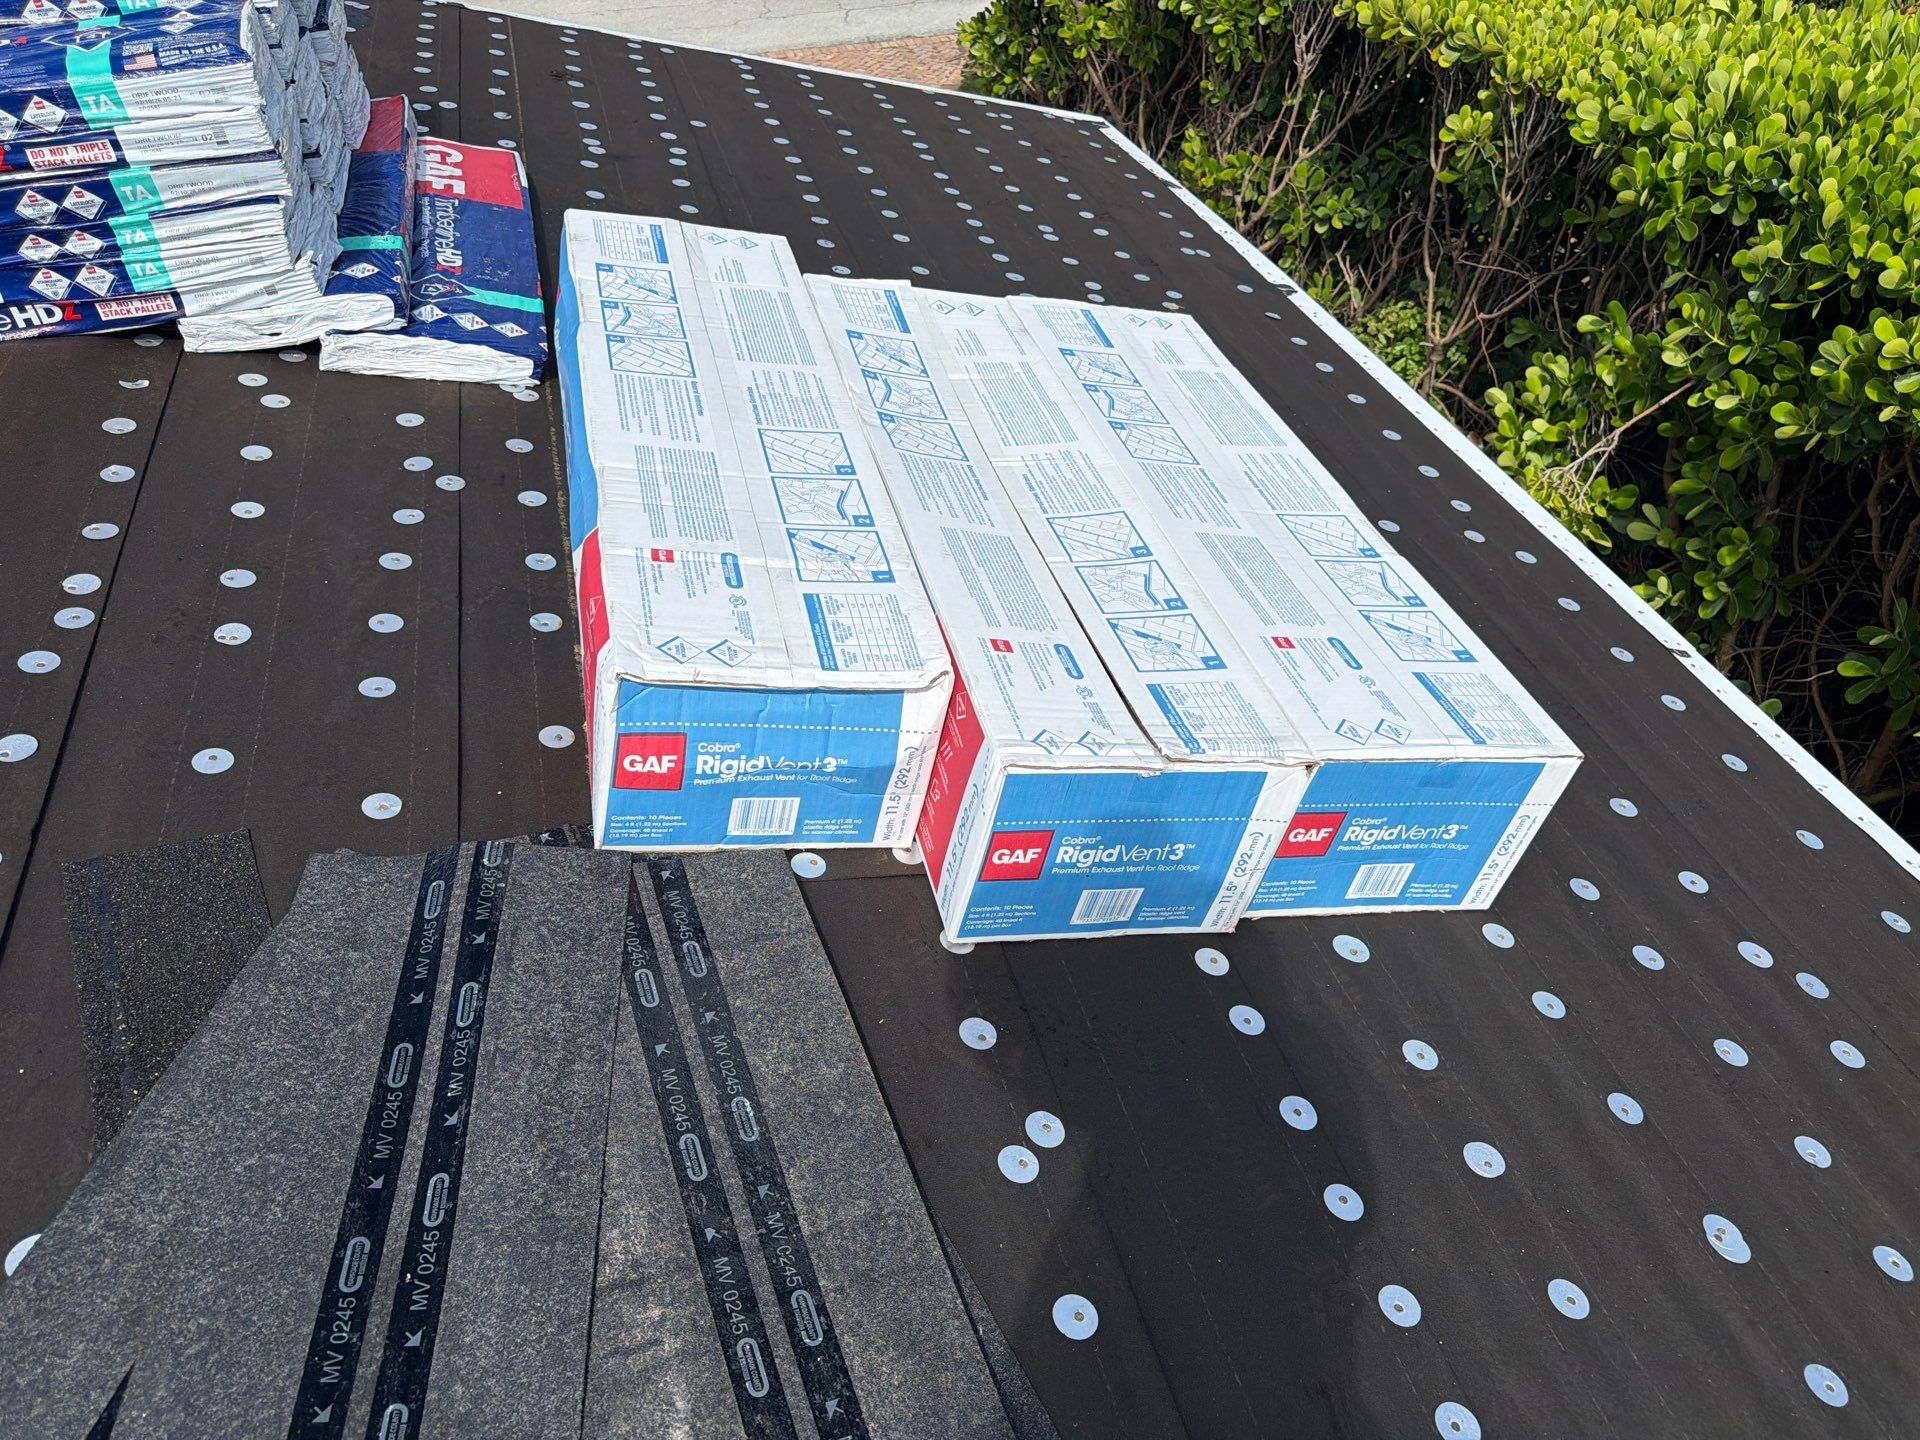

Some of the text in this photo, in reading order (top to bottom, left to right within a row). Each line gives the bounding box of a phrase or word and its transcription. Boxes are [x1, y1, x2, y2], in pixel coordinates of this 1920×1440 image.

[206, 43, 227, 52] U.S.A.
[132, 88, 179, 99] DRIFTWOOD
[83, 95, 119, 113] TA
[202, 134, 214, 142] 02
[30, 142, 110, 160] DO NOT TRIPLE
[34, 151, 113, 169] STACK PALLETS
[416, 145, 465, 195] GAF
[121, 185, 153, 201] TA
[168, 180, 213, 190] DRIFTWOOD
[122, 230, 149, 244] TA
[133, 264, 162, 277] TA
[103, 303, 173, 318] STACK PALLETS
[117, 300, 134, 308] NOT
[138, 296, 170, 306] TRIPLE
[623, 755, 678, 774] GAF
[694, 776, 736, 786] Premium
[738, 774, 773, 782] Exhaust
[832, 776, 858, 785] Ridge
[883, 746, 919, 841] Width: (292 mm)
[1288, 828, 1334, 843] GAF
[1448, 843, 1469, 851] Ridge
[1480, 859, 1499, 882] 11.5"
[1497, 833, 1518, 856] (292
[1515, 815, 1531, 833] mm)
[992, 848, 1043, 865] GAF
[1092, 866, 1125, 874] Exhaust
[1177, 865, 1201, 873] Ridge
[1210, 832, 1265, 927] Width: 11.5" (292 mm)
[475, 869, 498, 920] MV 0245
[667, 890, 694, 939] MV 0245
[414, 921, 437, 979] MV 0245
[627, 939, 646, 967] 0245
[448, 1029, 471, 1097] MV 0245
[712, 1034, 742, 1095] MV 0245
[662, 1068, 692, 1131] MV 0245
[373, 1092, 403, 1159] MV 0245
[766, 1211, 788, 1239] MV
[410, 1230, 440, 1311] MV 0245
[713, 1257, 749, 1336] MV 0245
[320, 1298, 357, 1383] MV 0245
